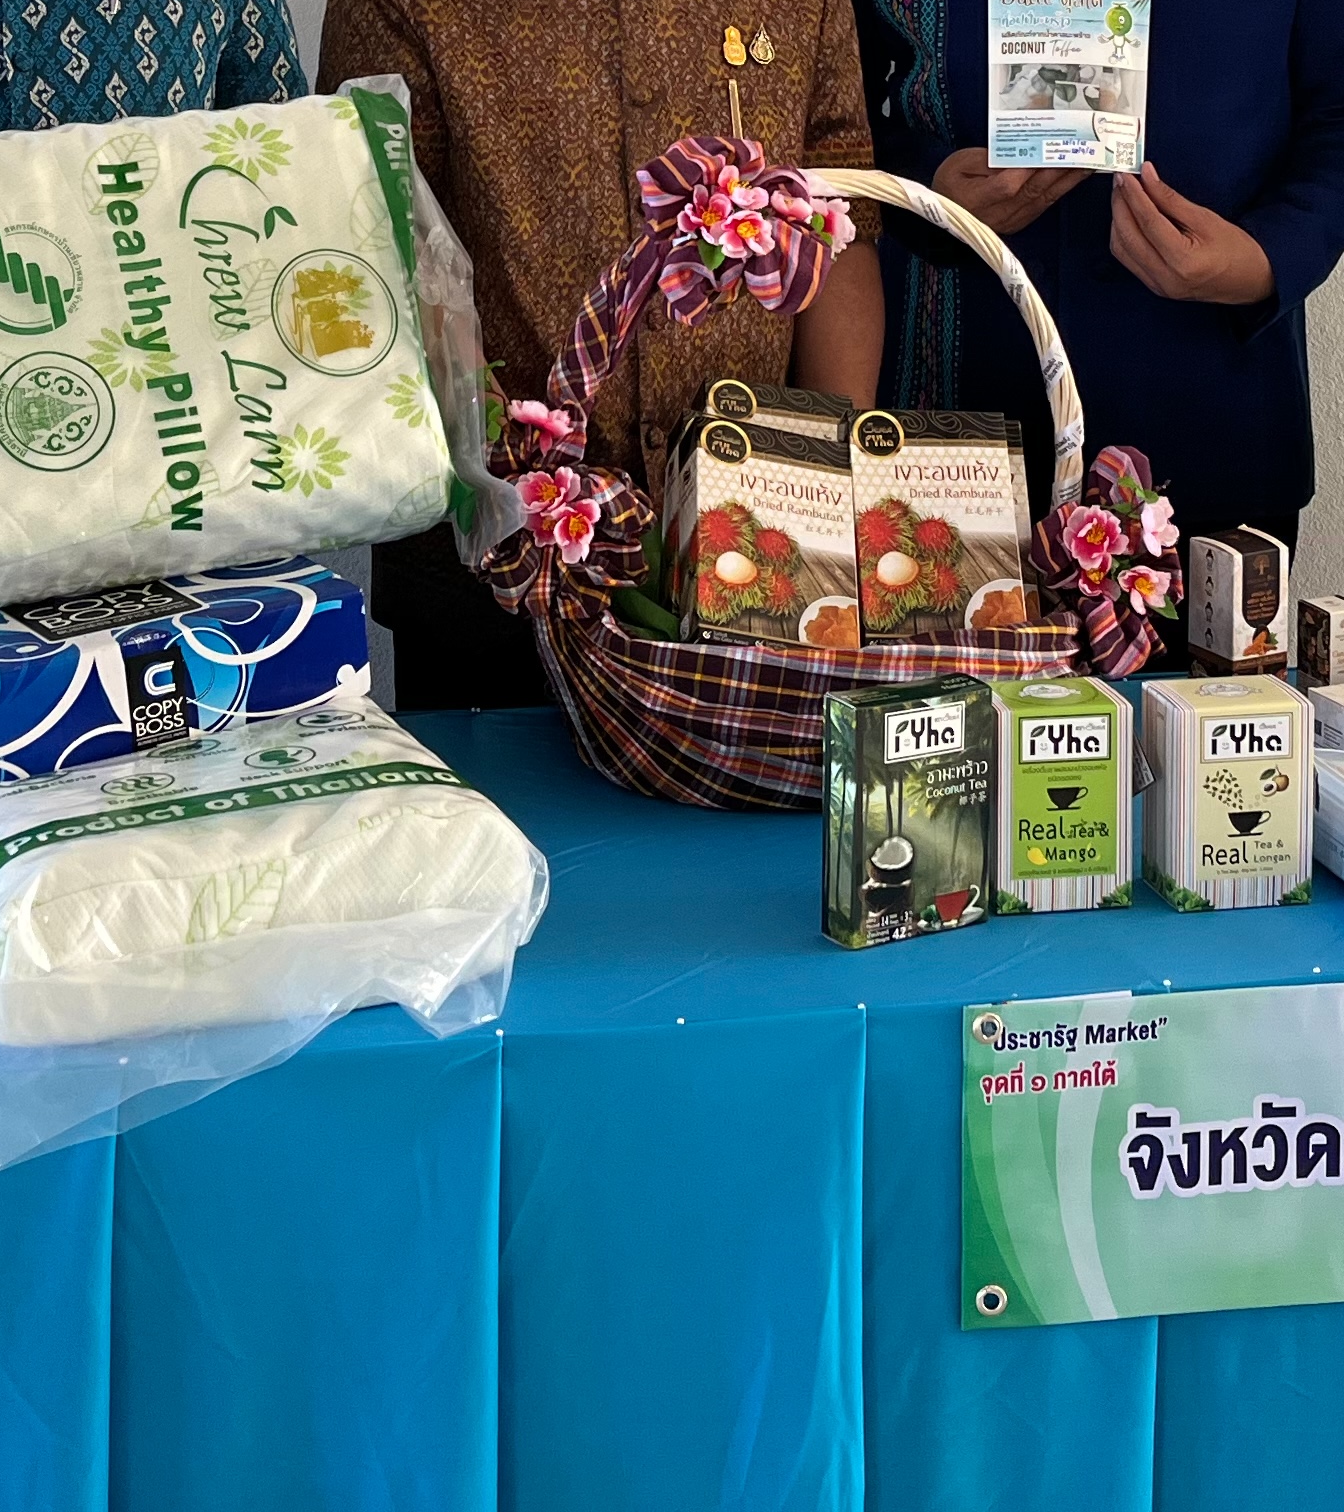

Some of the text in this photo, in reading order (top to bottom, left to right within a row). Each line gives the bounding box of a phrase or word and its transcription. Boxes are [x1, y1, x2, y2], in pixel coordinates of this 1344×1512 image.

[1001, 40, 1047, 55] COCONUT
[97, 162, 211, 534] Healthy Pillow
[218, 350, 291, 493] Larn
[894, 460, 1000, 482] เงาะอบแห้ง
[740, 472, 843, 506] เงาะอบแห้ง
[909, 488, 1003, 500] Dried Rambutan
[753, 496, 845, 524] Dried Rambutan
[22, 583, 153, 620] COPY
[38, 593, 174, 630] BOSS
[132, 695, 184, 722] COPY
[135, 712, 185, 738] BOSS
[926, 759, 989, 785] ชามะพร้าว
[925, 777, 988, 800] Coconut Tea
[3, 803, 186, 857] Product
[204, 791, 251, 811] of
[1018, 815, 1110, 842] Real Tea &
[1045, 846, 1097, 863] Mango
[1202, 838, 1285, 867] Real Tea &
[1253, 853, 1292, 864] Longan
[982, 1060, 1117, 1103] จุดที่ ๑ ภาคใต้
